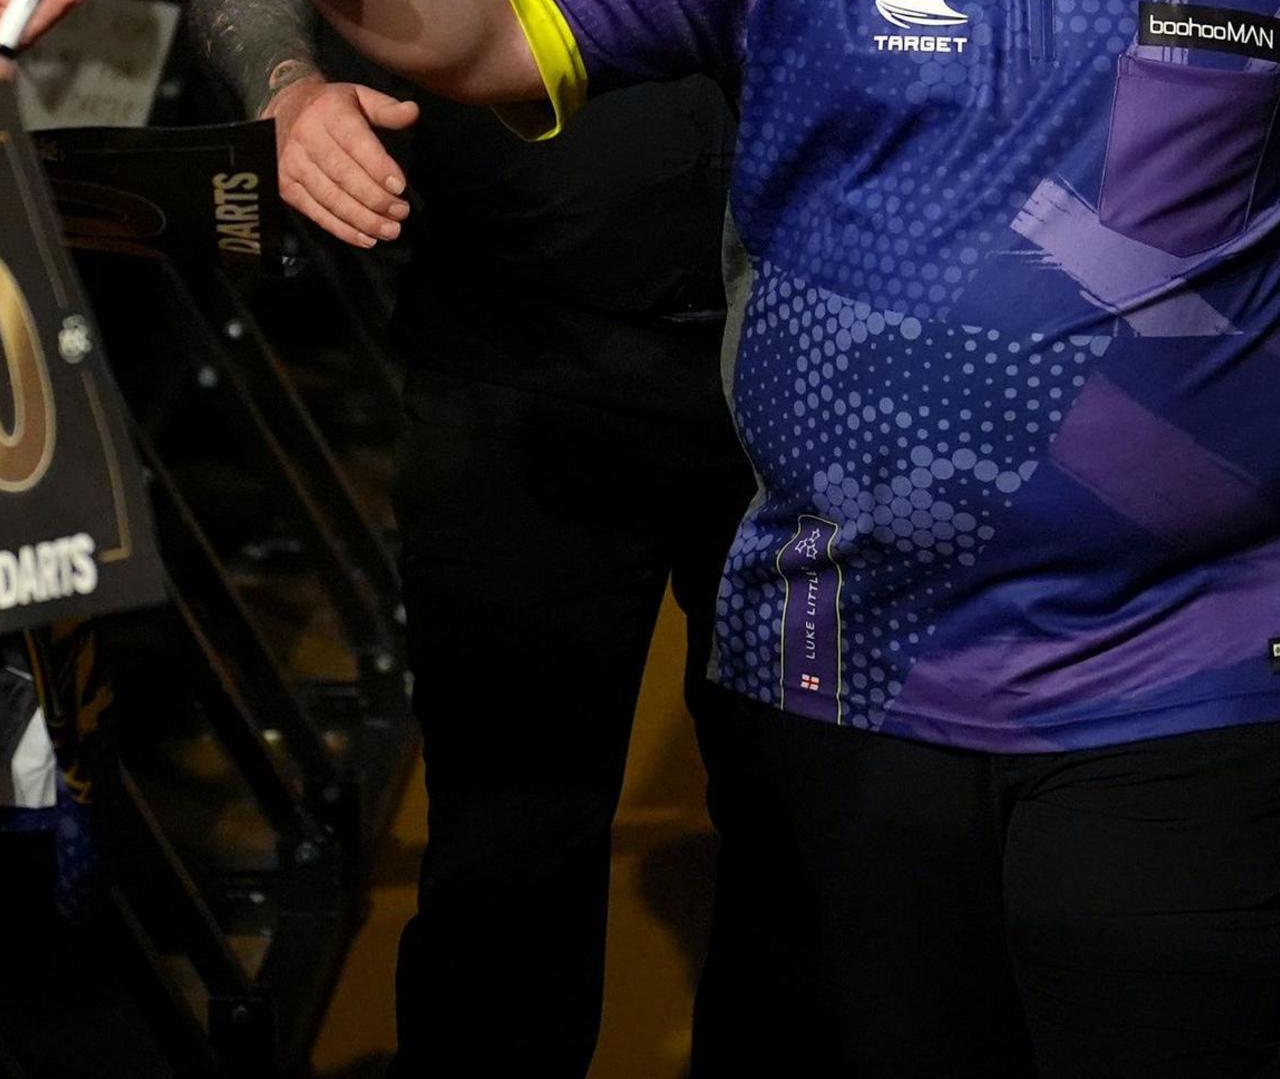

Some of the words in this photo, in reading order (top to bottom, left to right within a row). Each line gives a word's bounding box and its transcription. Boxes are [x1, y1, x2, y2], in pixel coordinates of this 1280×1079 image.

[873, 35, 968, 53] TARGET
[1149, 13, 1275, 50] boohooMAN
[805, 620, 816, 660] LUKE
